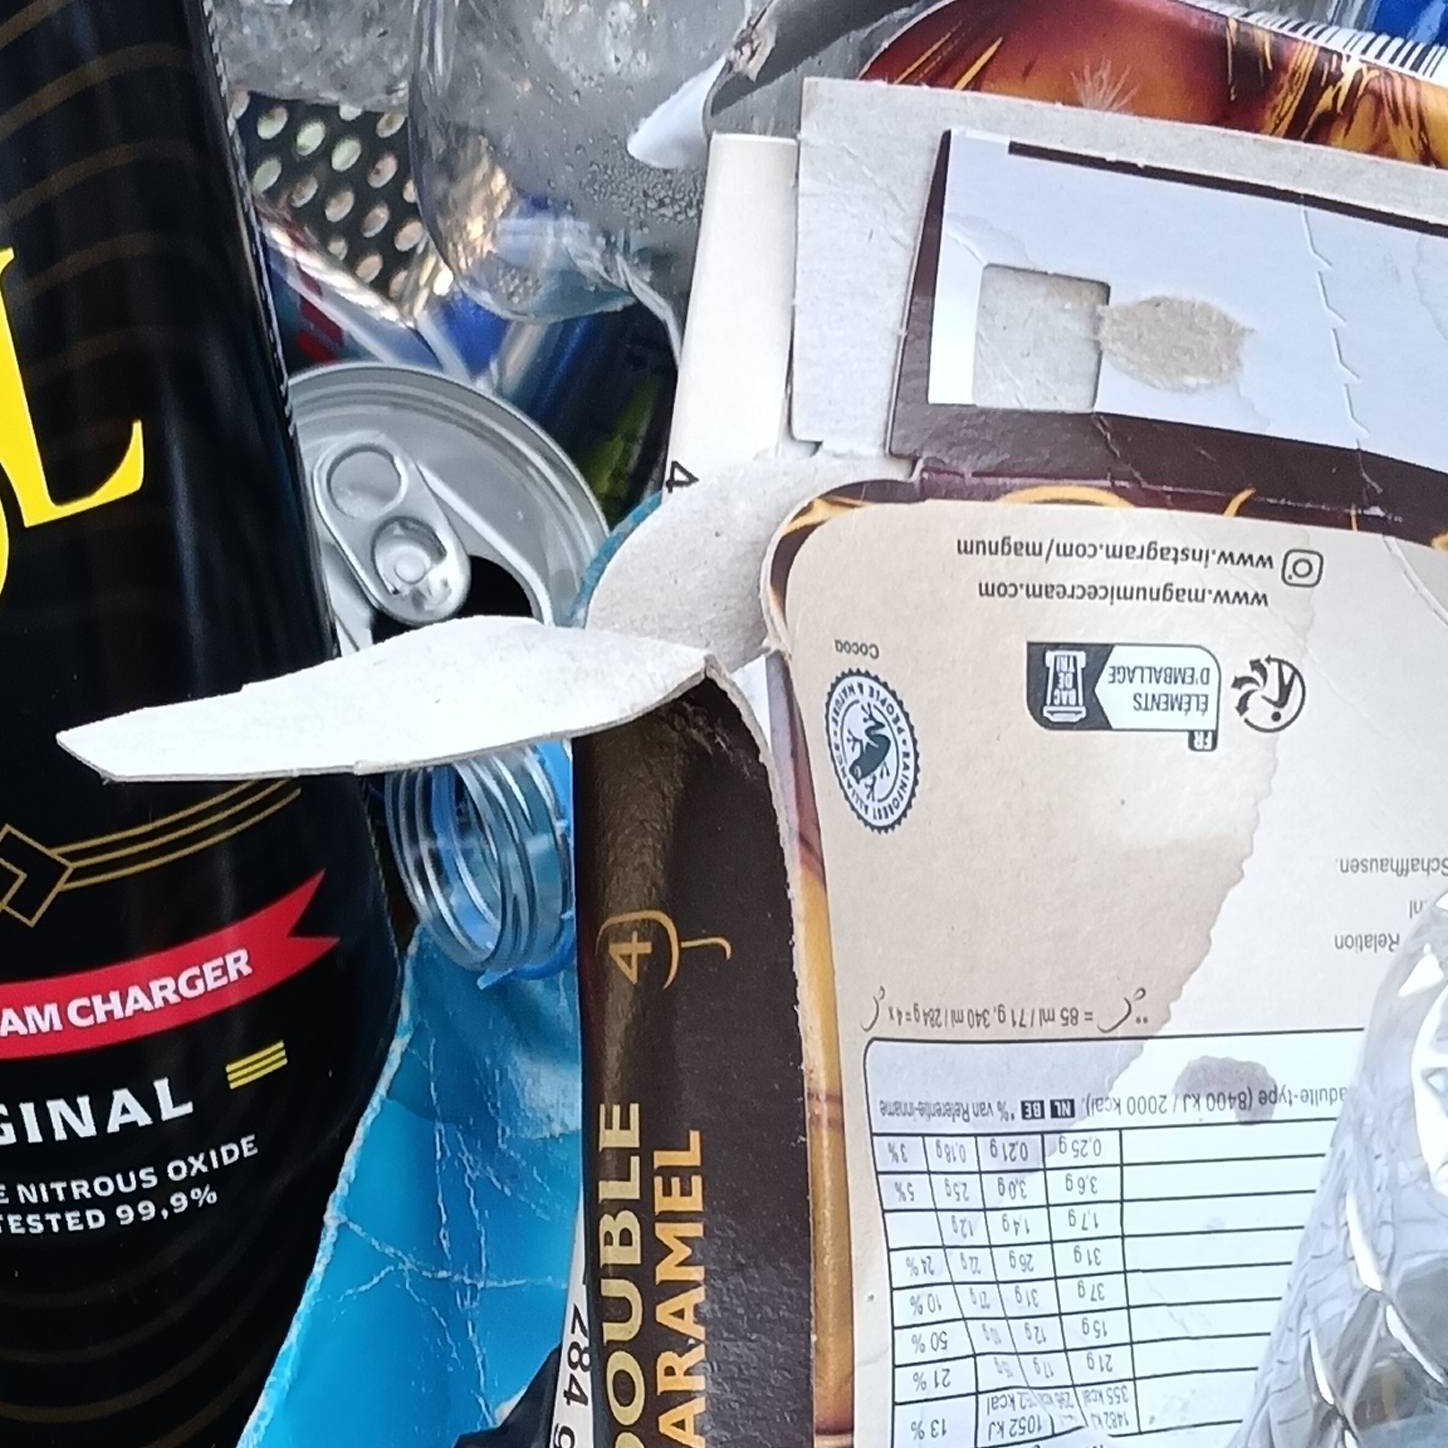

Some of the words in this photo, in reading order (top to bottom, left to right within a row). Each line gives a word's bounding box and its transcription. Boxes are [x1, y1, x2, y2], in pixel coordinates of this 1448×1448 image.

[956, 537, 1274, 571] www.instagram.com/magnum
[978, 581, 1269, 608] www.magnumicecream.com
[834, 638, 880, 660] Cocoa
[1107, 664, 1211, 686] D'EMBALLAGE
[1132, 690, 1210, 714] ÉLÉMENTS
[1192, 730, 1214, 750] FR
[1334, 932, 1401, 953] Relation
[66, 948, 254, 1028] CHARGER
[967, 1007, 991, 1028] 340
[1011, 1007, 1028, 1027] 71
[1060, 1006, 1080, 1027] 85
[1023, 1101, 1042, 1119] BE
[1054, 1101, 1072, 1117] NL
[1126, 1092, 1169, 1113] 2000
[1207, 1088, 1254, 1114] (8400
[17, 1167, 158, 1206] NITROUS
[166, 1133, 259, 1185] OXIDE
[114, 1184, 219, 1228] 99,9%
[1017, 1254, 1035, 1272] 26
[1085, 1247, 1102, 1266] 31
[1089, 1281, 1105, 1301] 37
[927, 1293, 942, 1312] 10
[1092, 1318, 1108, 1339] 15
[931, 1330, 949, 1352] 50
[1096, 1354, 1113, 1373] 21
[934, 1367, 952, 1388] 21
[987, 1392, 1016, 1417] kcal
[929, 1418, 948, 1439] 13
[1008, 1414, 1043, 1435] 1052
